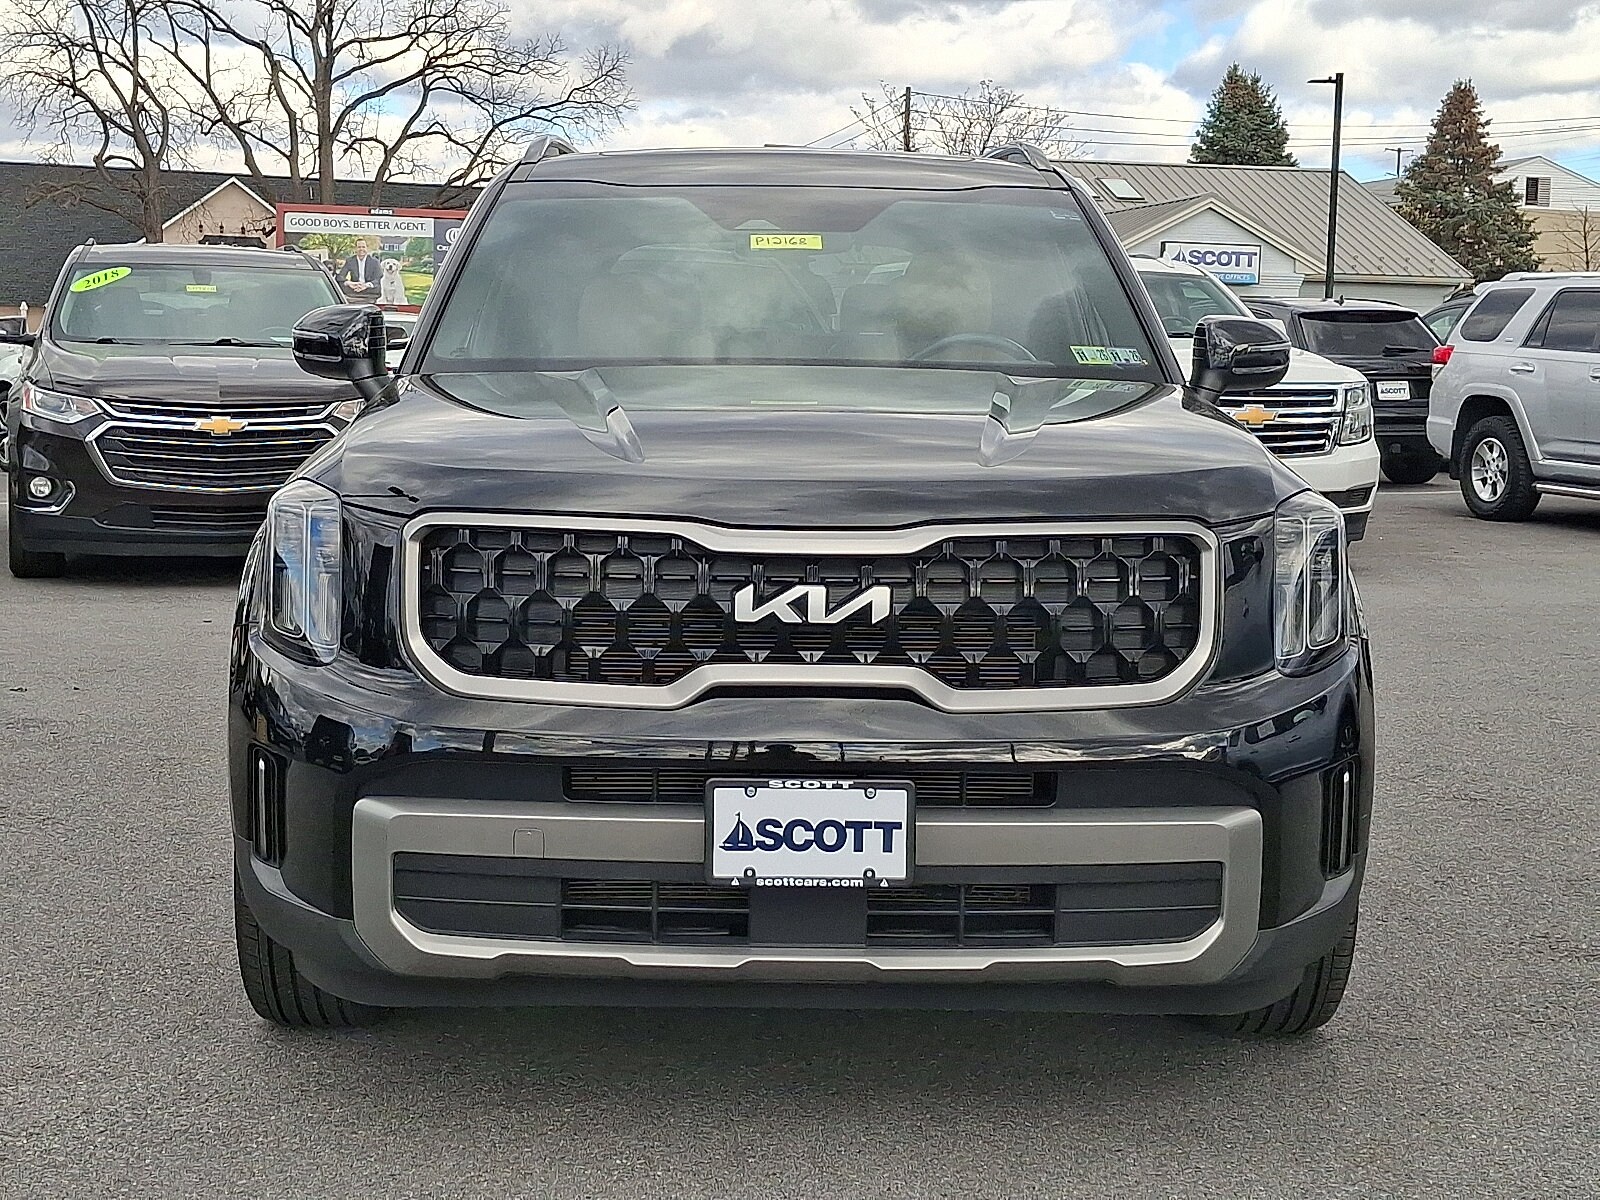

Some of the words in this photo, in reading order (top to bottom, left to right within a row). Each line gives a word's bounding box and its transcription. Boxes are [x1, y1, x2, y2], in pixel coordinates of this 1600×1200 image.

[290, 217, 321, 227] GOOD
[323, 219, 351, 229] BOYS.
[353, 220, 390, 230] BETTER
[394, 222, 426, 231] AGENT.
[1188, 249, 1257, 267] SCOTT
[84, 268, 119, 289] 2018
[734, 583, 891, 625] KIA
[768, 780, 854, 789] SCOTT
[755, 818, 902, 853] SCOTT
[756, 877, 864, 888] scottcars.com
